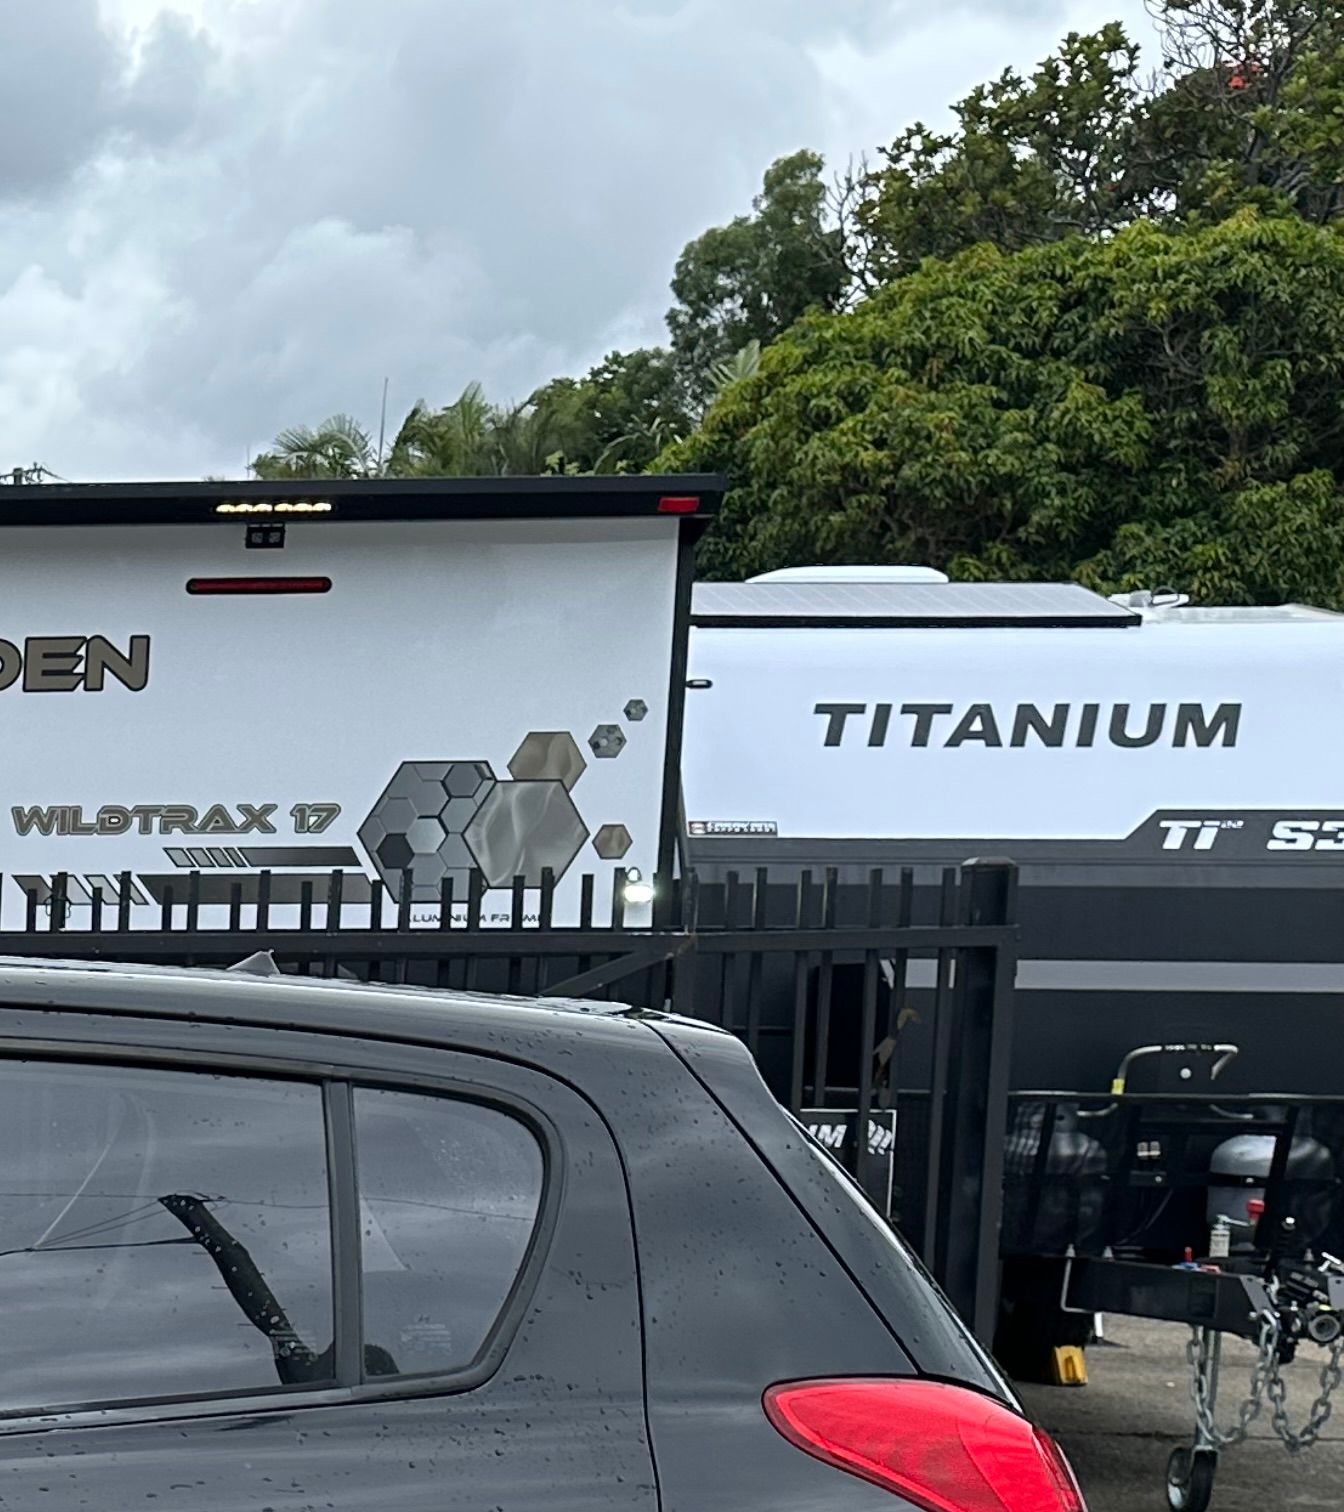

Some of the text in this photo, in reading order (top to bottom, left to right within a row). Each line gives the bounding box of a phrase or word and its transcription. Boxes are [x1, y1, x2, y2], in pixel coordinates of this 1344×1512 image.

[813, 702, 1242, 748] TITANIUM
[11, 803, 342, 836] WILDTRAX 17
[1159, 820, 1221, 850] Ti
